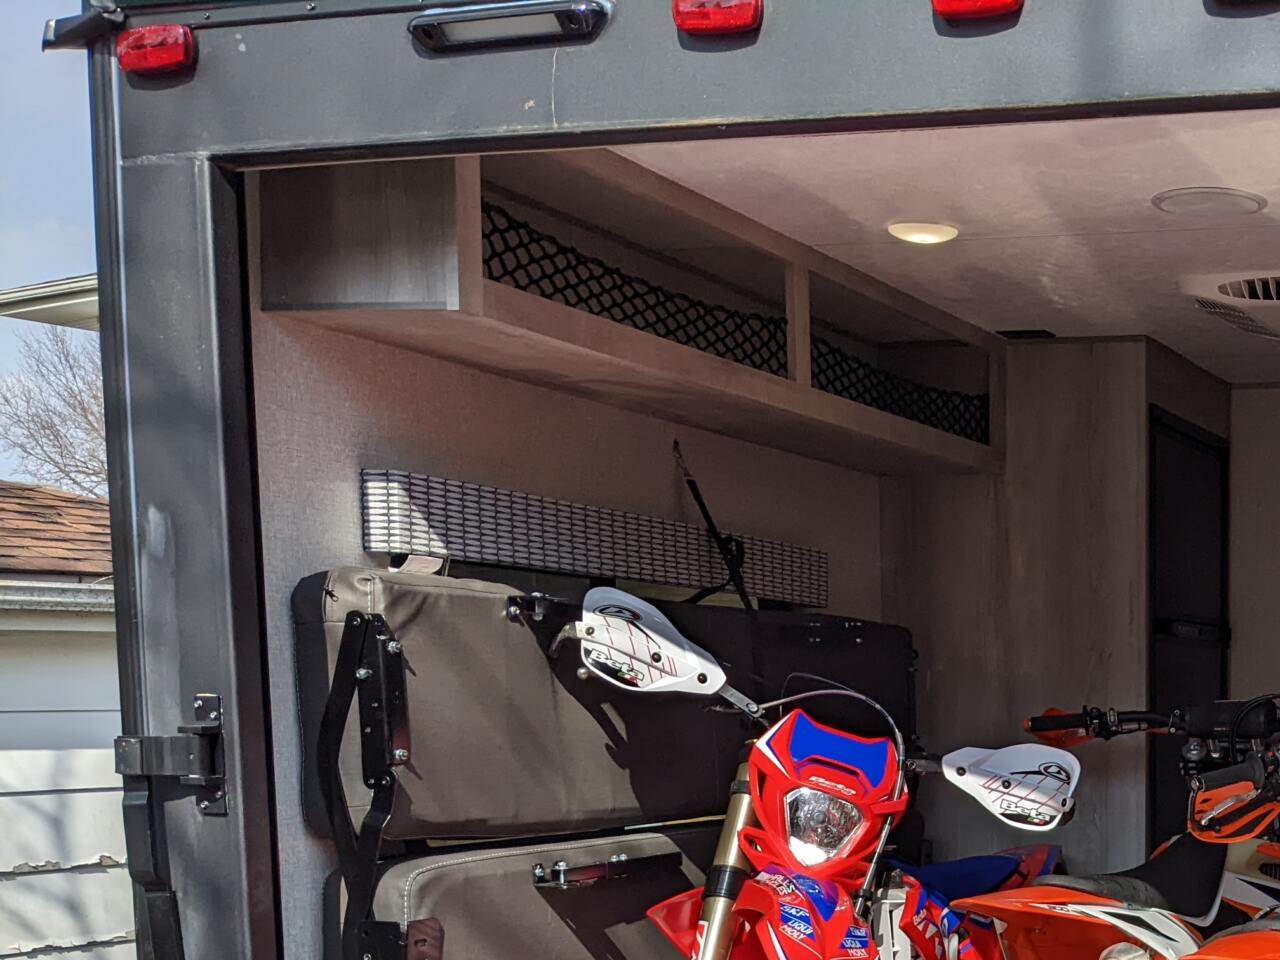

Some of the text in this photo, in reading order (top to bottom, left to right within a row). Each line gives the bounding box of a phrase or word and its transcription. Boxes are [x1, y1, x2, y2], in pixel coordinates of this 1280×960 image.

[586, 648, 645, 682] Beta
[808, 775, 857, 796] Beta
[1000, 798, 1051, 821] Beta
[780, 903, 810, 918] SKF
[779, 924, 807, 940] MOLY
[787, 919, 814, 936] LIQUI
